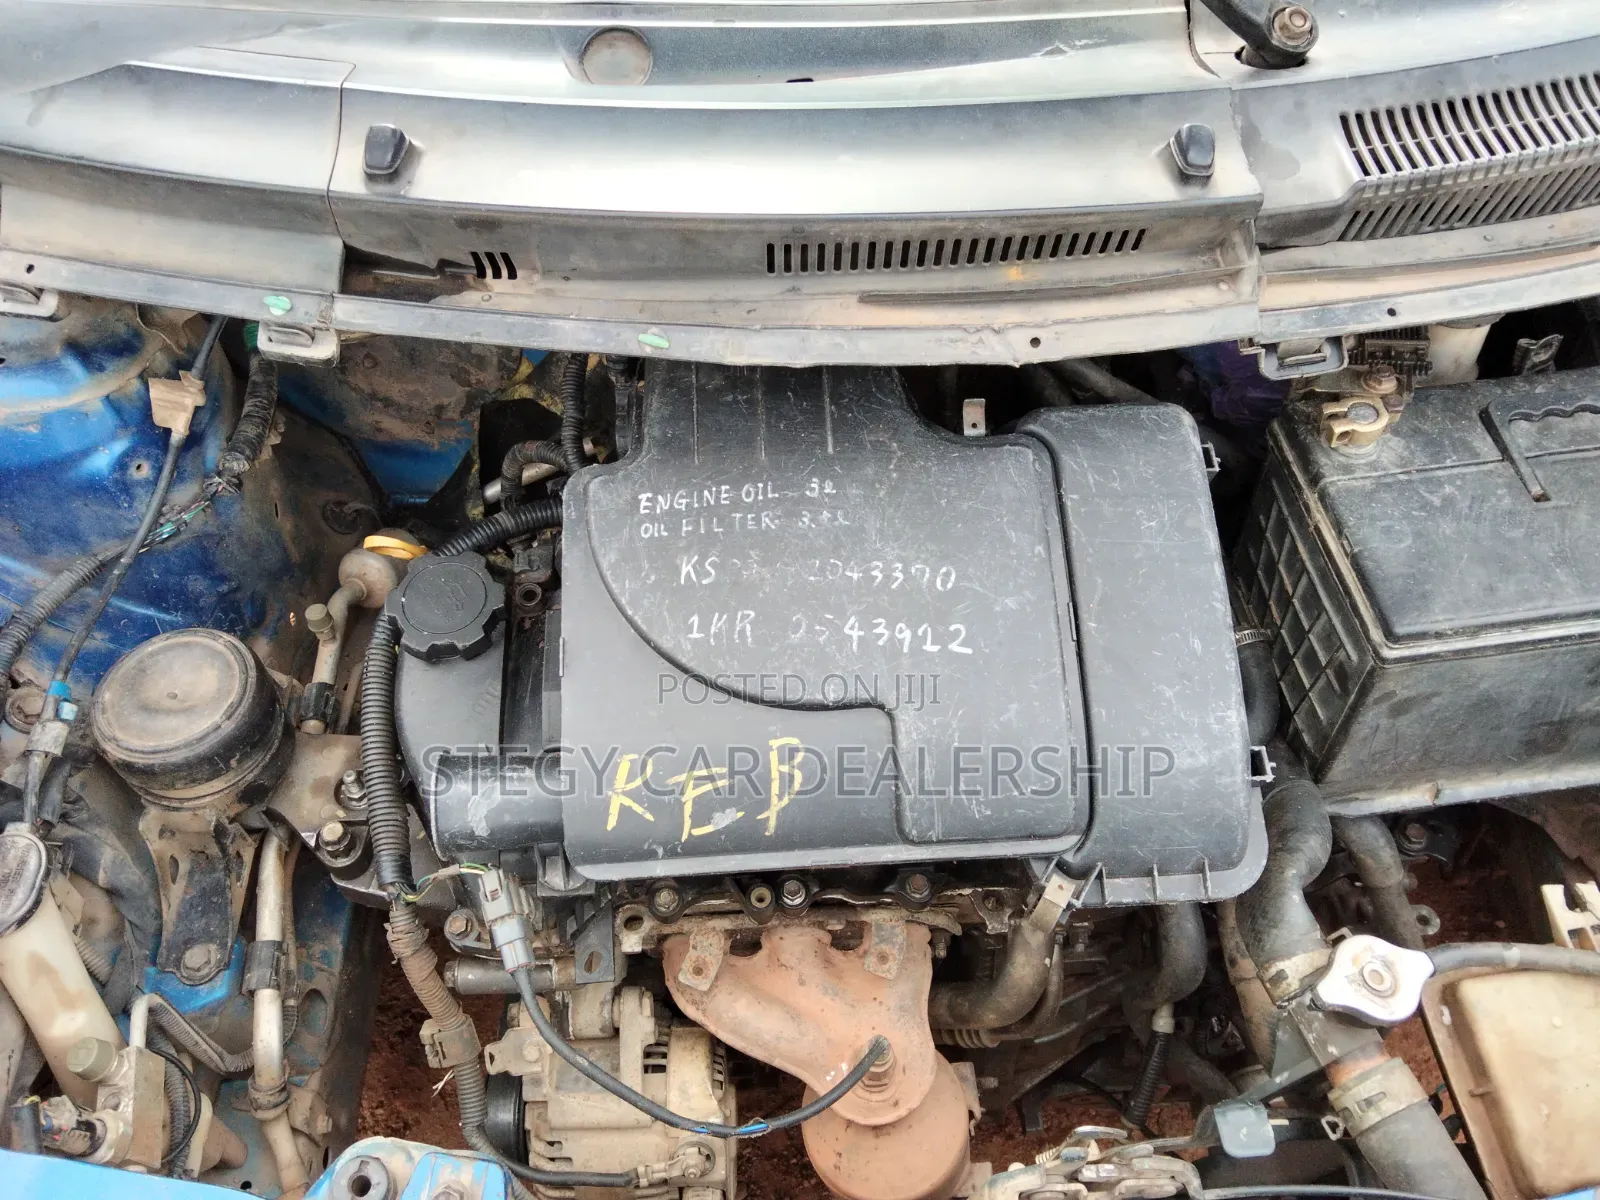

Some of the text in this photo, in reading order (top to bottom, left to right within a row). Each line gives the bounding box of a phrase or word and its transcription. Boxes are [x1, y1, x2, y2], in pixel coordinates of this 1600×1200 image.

[638, 485, 731, 514] ENGINE
[741, 481, 779, 502] OIL
[640, 522, 669, 538] OIL
